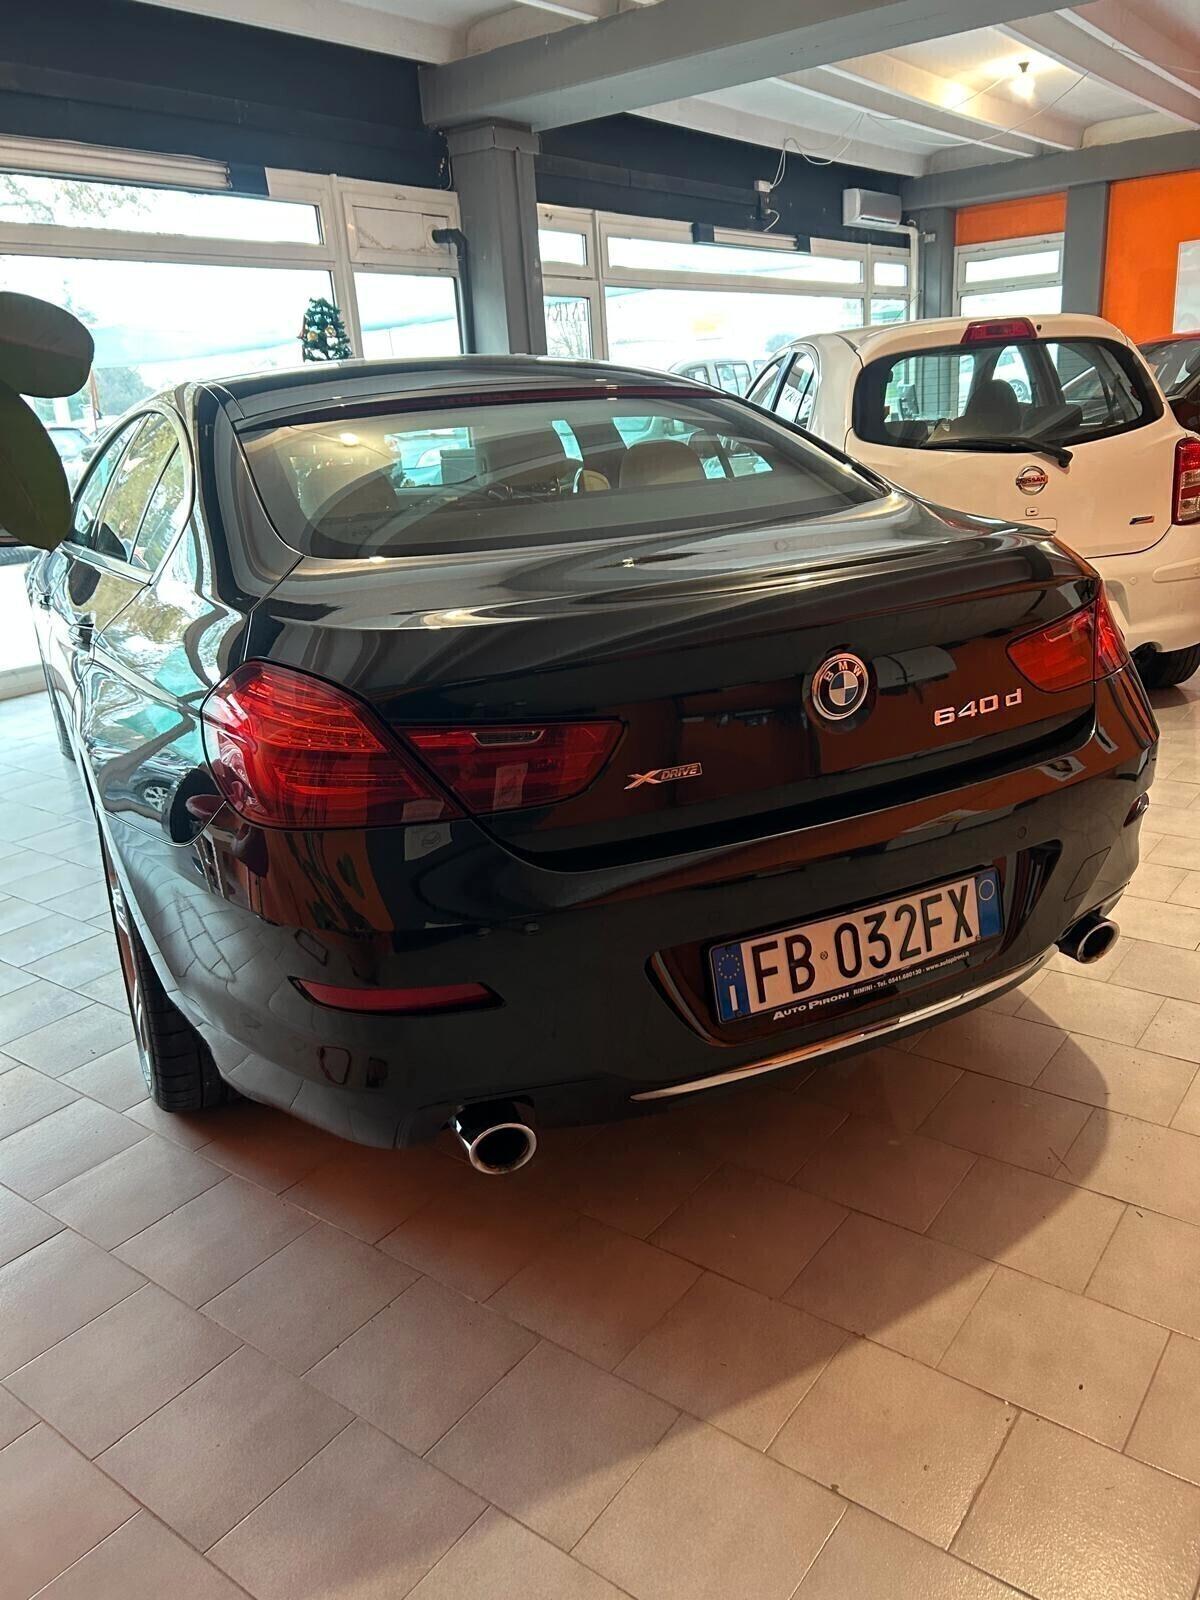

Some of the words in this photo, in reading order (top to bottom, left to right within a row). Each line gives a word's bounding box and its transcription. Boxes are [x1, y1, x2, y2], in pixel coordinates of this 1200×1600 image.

[823, 660, 863, 683] BMW
[751, 934, 816, 1004] FB
[834, 884, 973, 979] 032FX
[773, 1005, 807, 1021] AUTO
[808, 992, 850, 1011] PIRONI
[853, 984, 873, 996] RIMINI
[877, 980, 888, 989] Tel.
